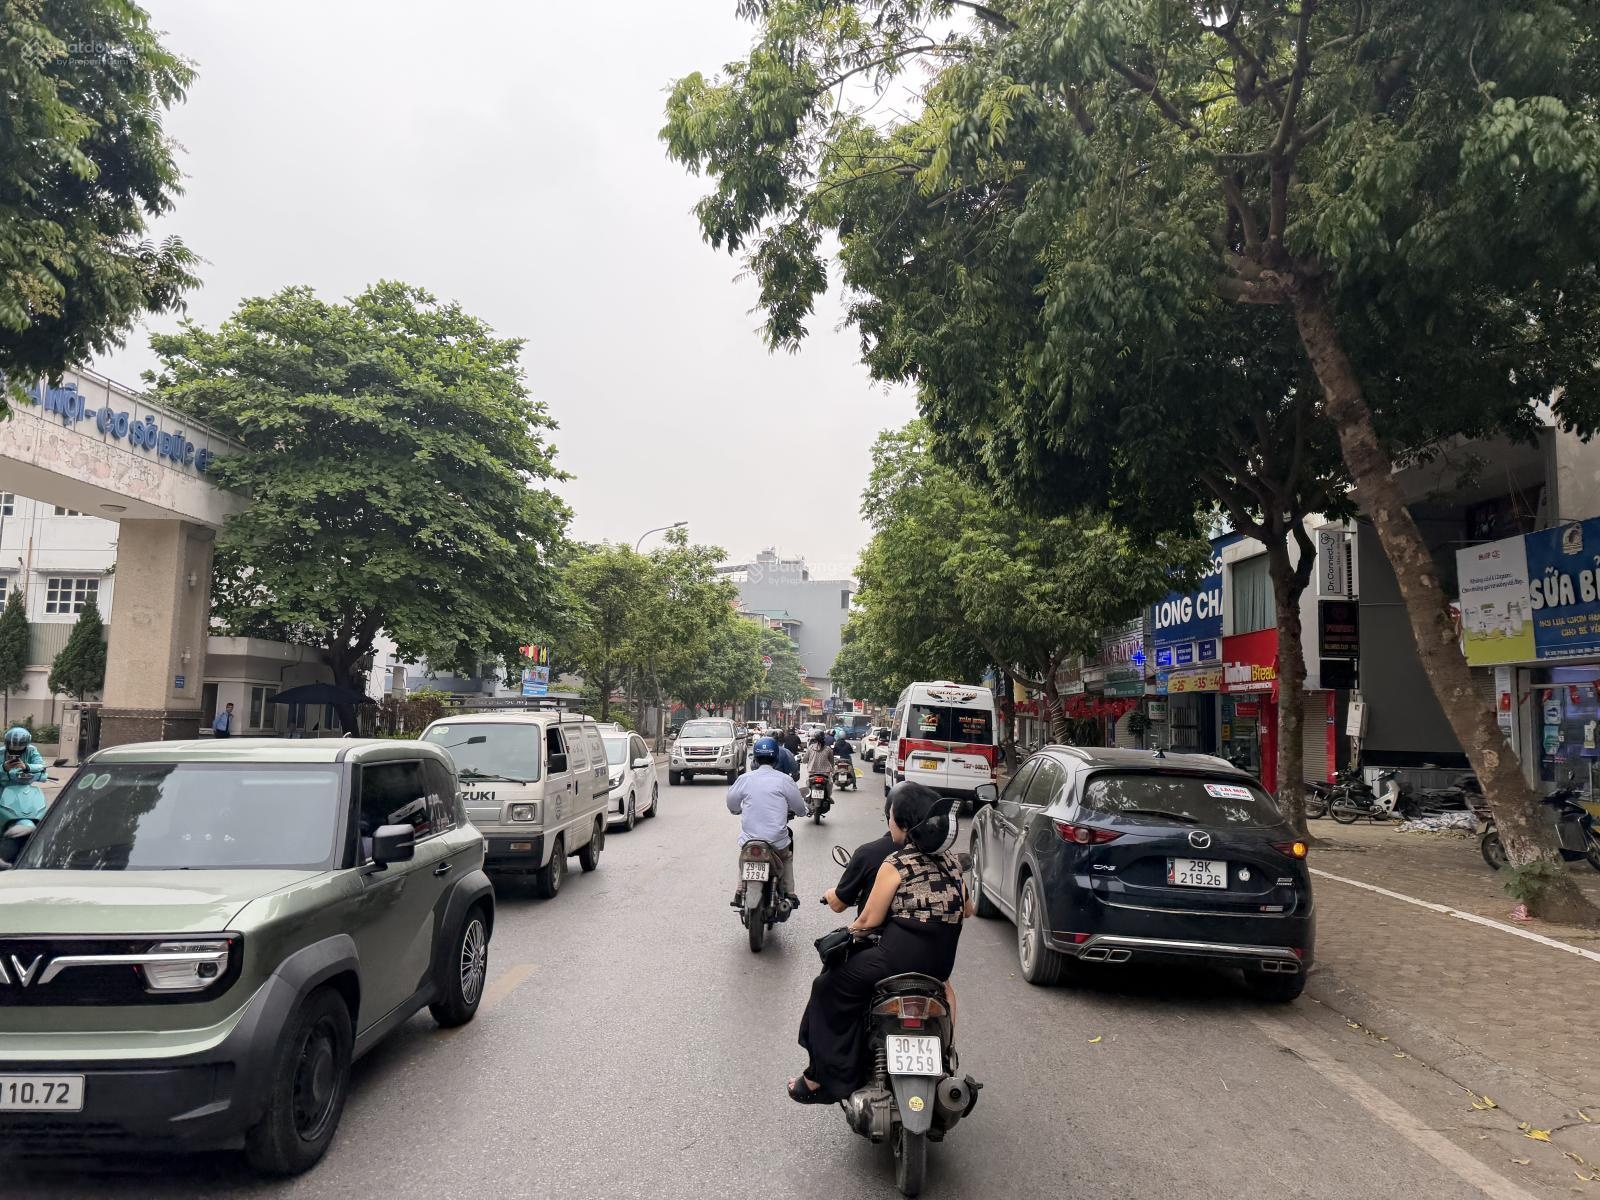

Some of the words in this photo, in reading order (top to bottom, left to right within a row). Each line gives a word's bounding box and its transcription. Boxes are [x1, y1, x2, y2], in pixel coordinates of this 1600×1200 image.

[1530, 567, 1576, 610] SỮA
[1155, 596, 1193, 630] LONG
[461, 791, 496, 801] ZUKI
[1189, 860, 1211, 873] 29K
[745, 871, 765, 880] 3294
[1180, 872, 1221, 886] 219.26
[895, 1038, 933, 1055] 30-K4
[895, 1055, 934, 1072] 5259
